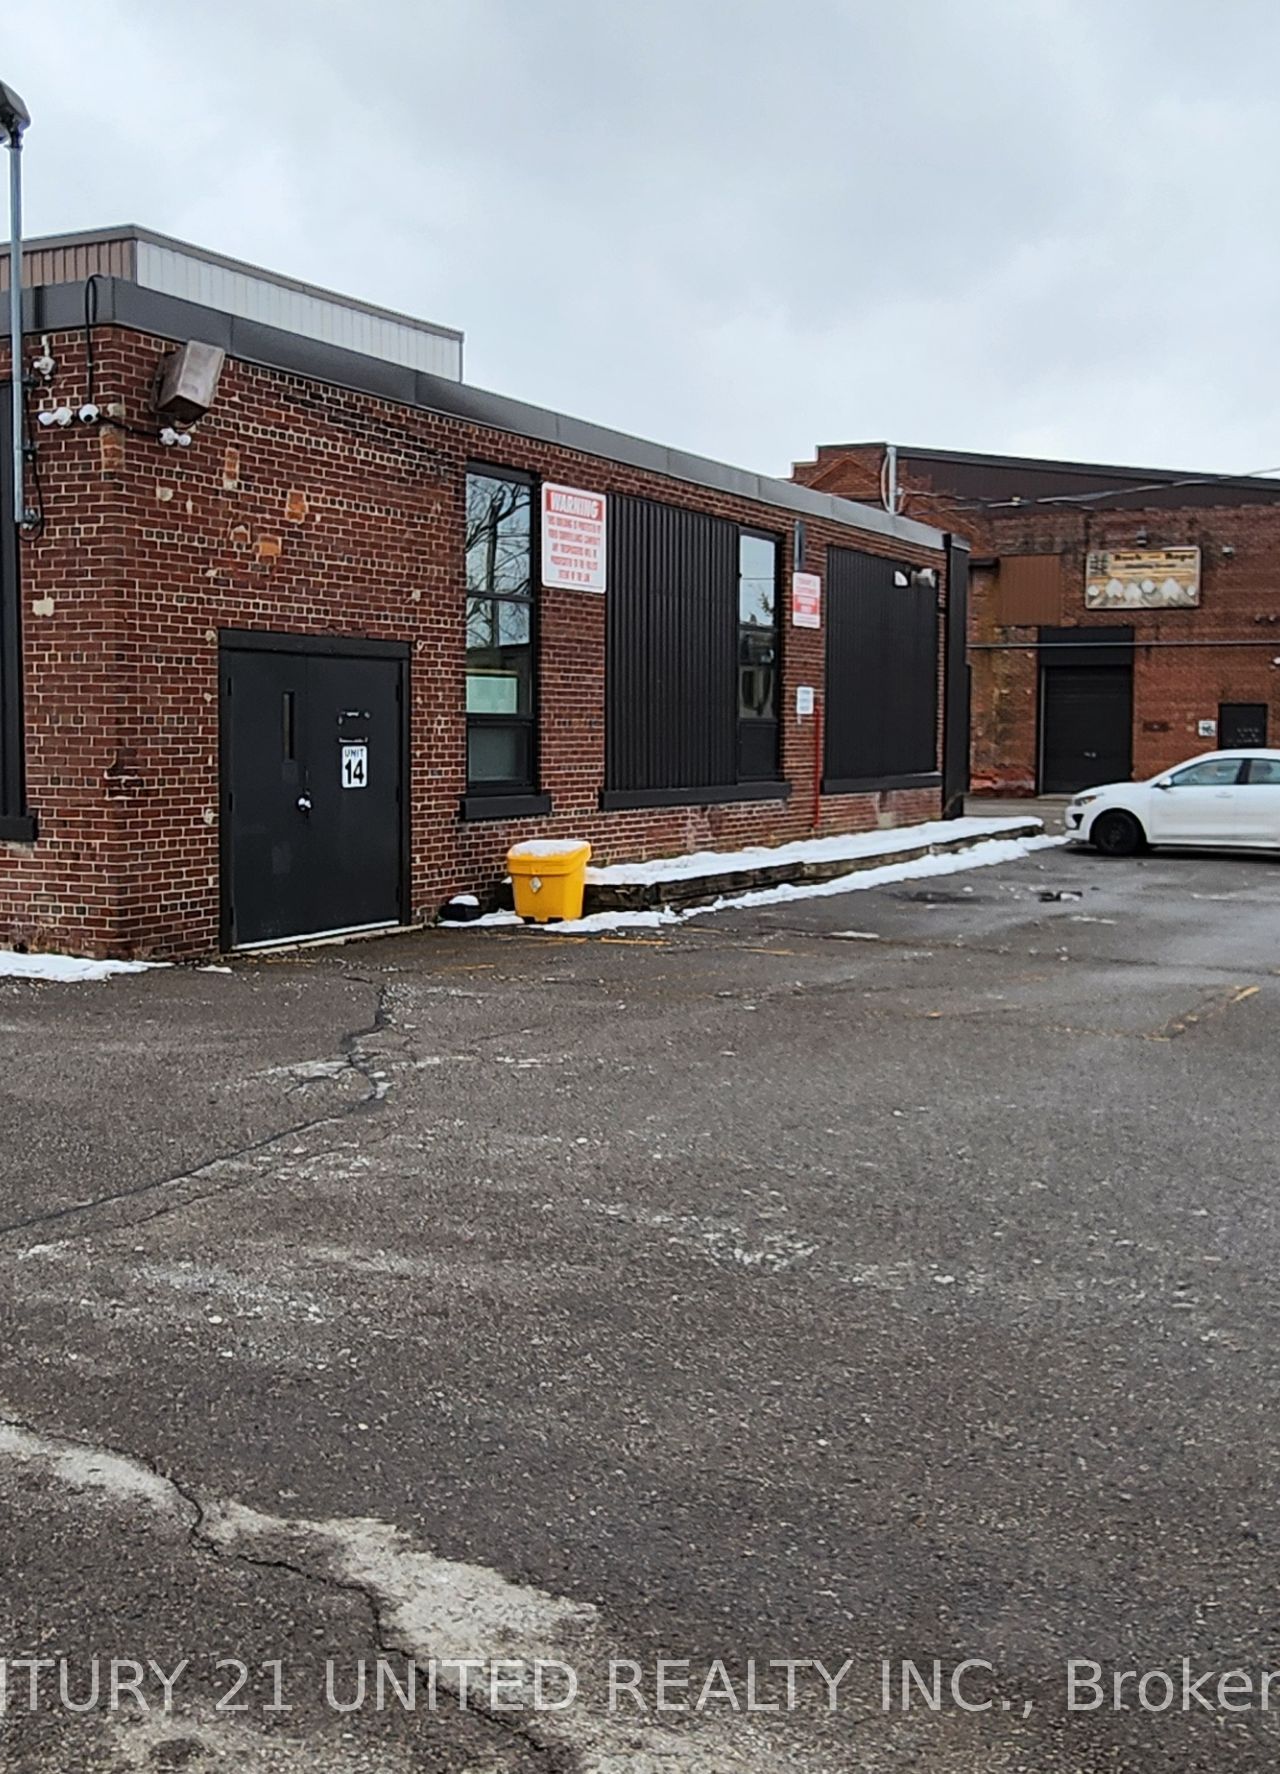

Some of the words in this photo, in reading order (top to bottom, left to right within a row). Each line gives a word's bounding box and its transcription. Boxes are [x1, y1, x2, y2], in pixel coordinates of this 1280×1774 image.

[550, 490, 600, 519] WARNING
[344, 748, 365, 758] UNIT
[345, 759, 365, 785] 14
